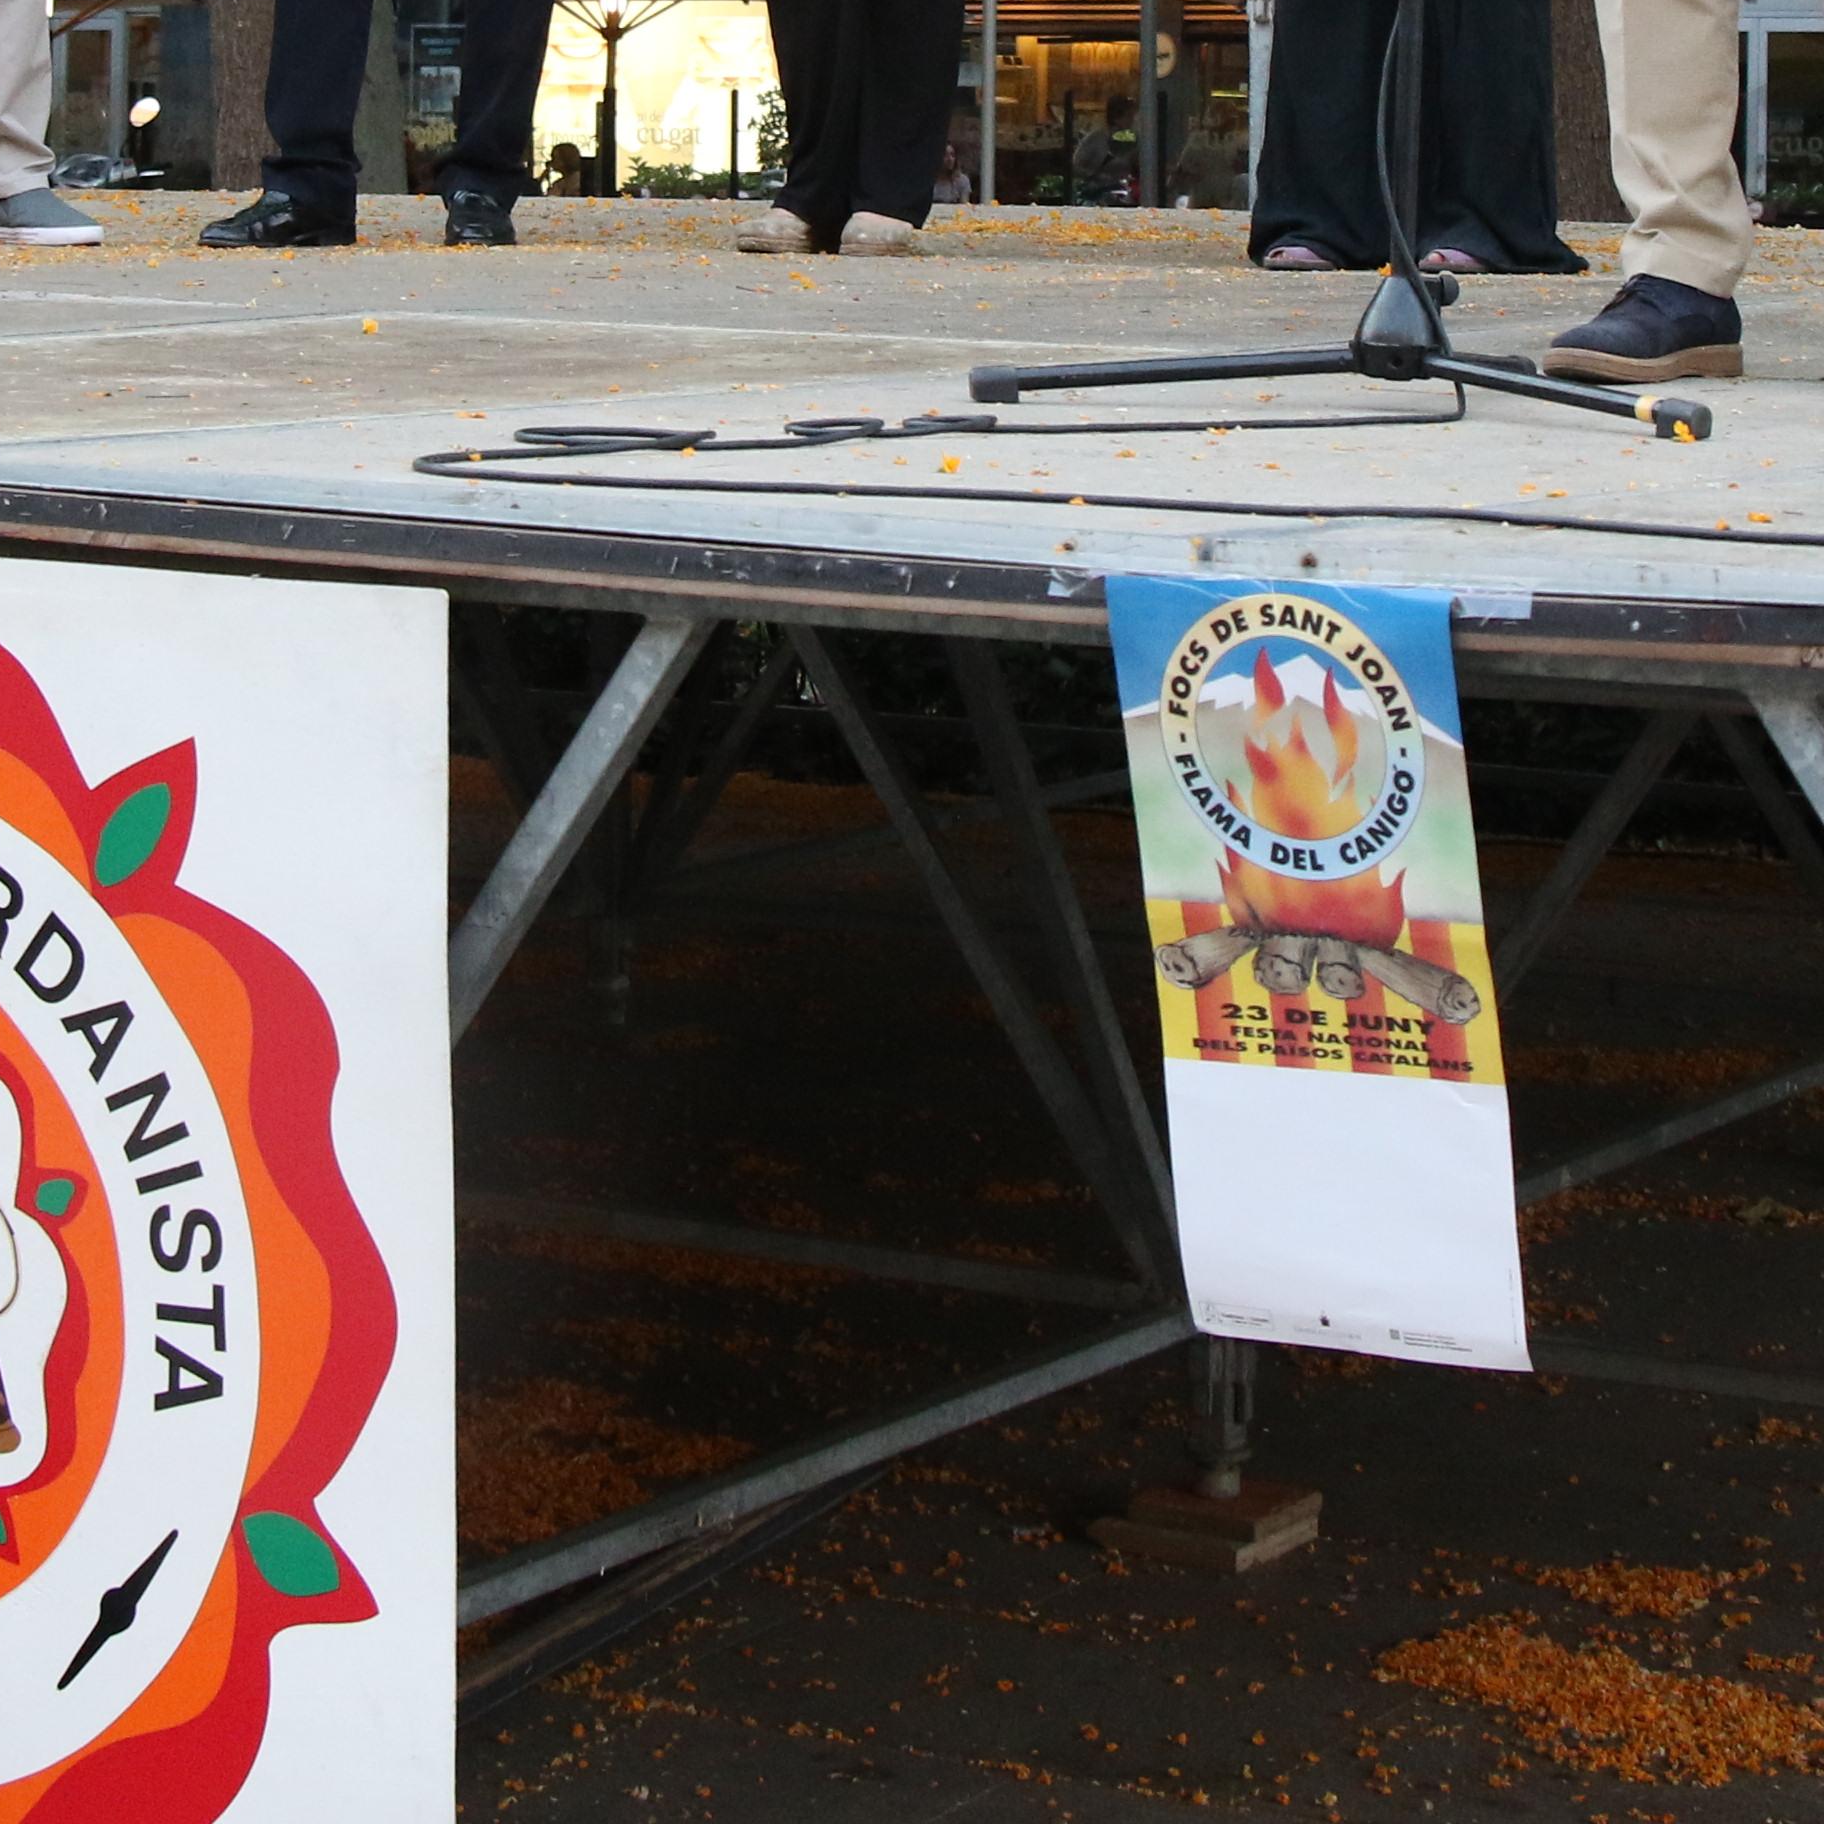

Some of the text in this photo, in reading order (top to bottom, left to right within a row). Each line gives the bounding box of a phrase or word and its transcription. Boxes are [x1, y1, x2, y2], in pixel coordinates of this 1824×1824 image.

[1169, 603, 1413, 732] FOCS DE SANT JOAN
[1175, 753, 1415, 872] FLAMA DEL CANIGÓ
[1221, 1003, 1436, 1036] 23 DE JUNY
[1192, 1037, 1249, 1053] DELS
[1353, 1050, 1475, 1073] CATALANS
[1230, 1025, 1433, 1053] FESTA NACIONAL
